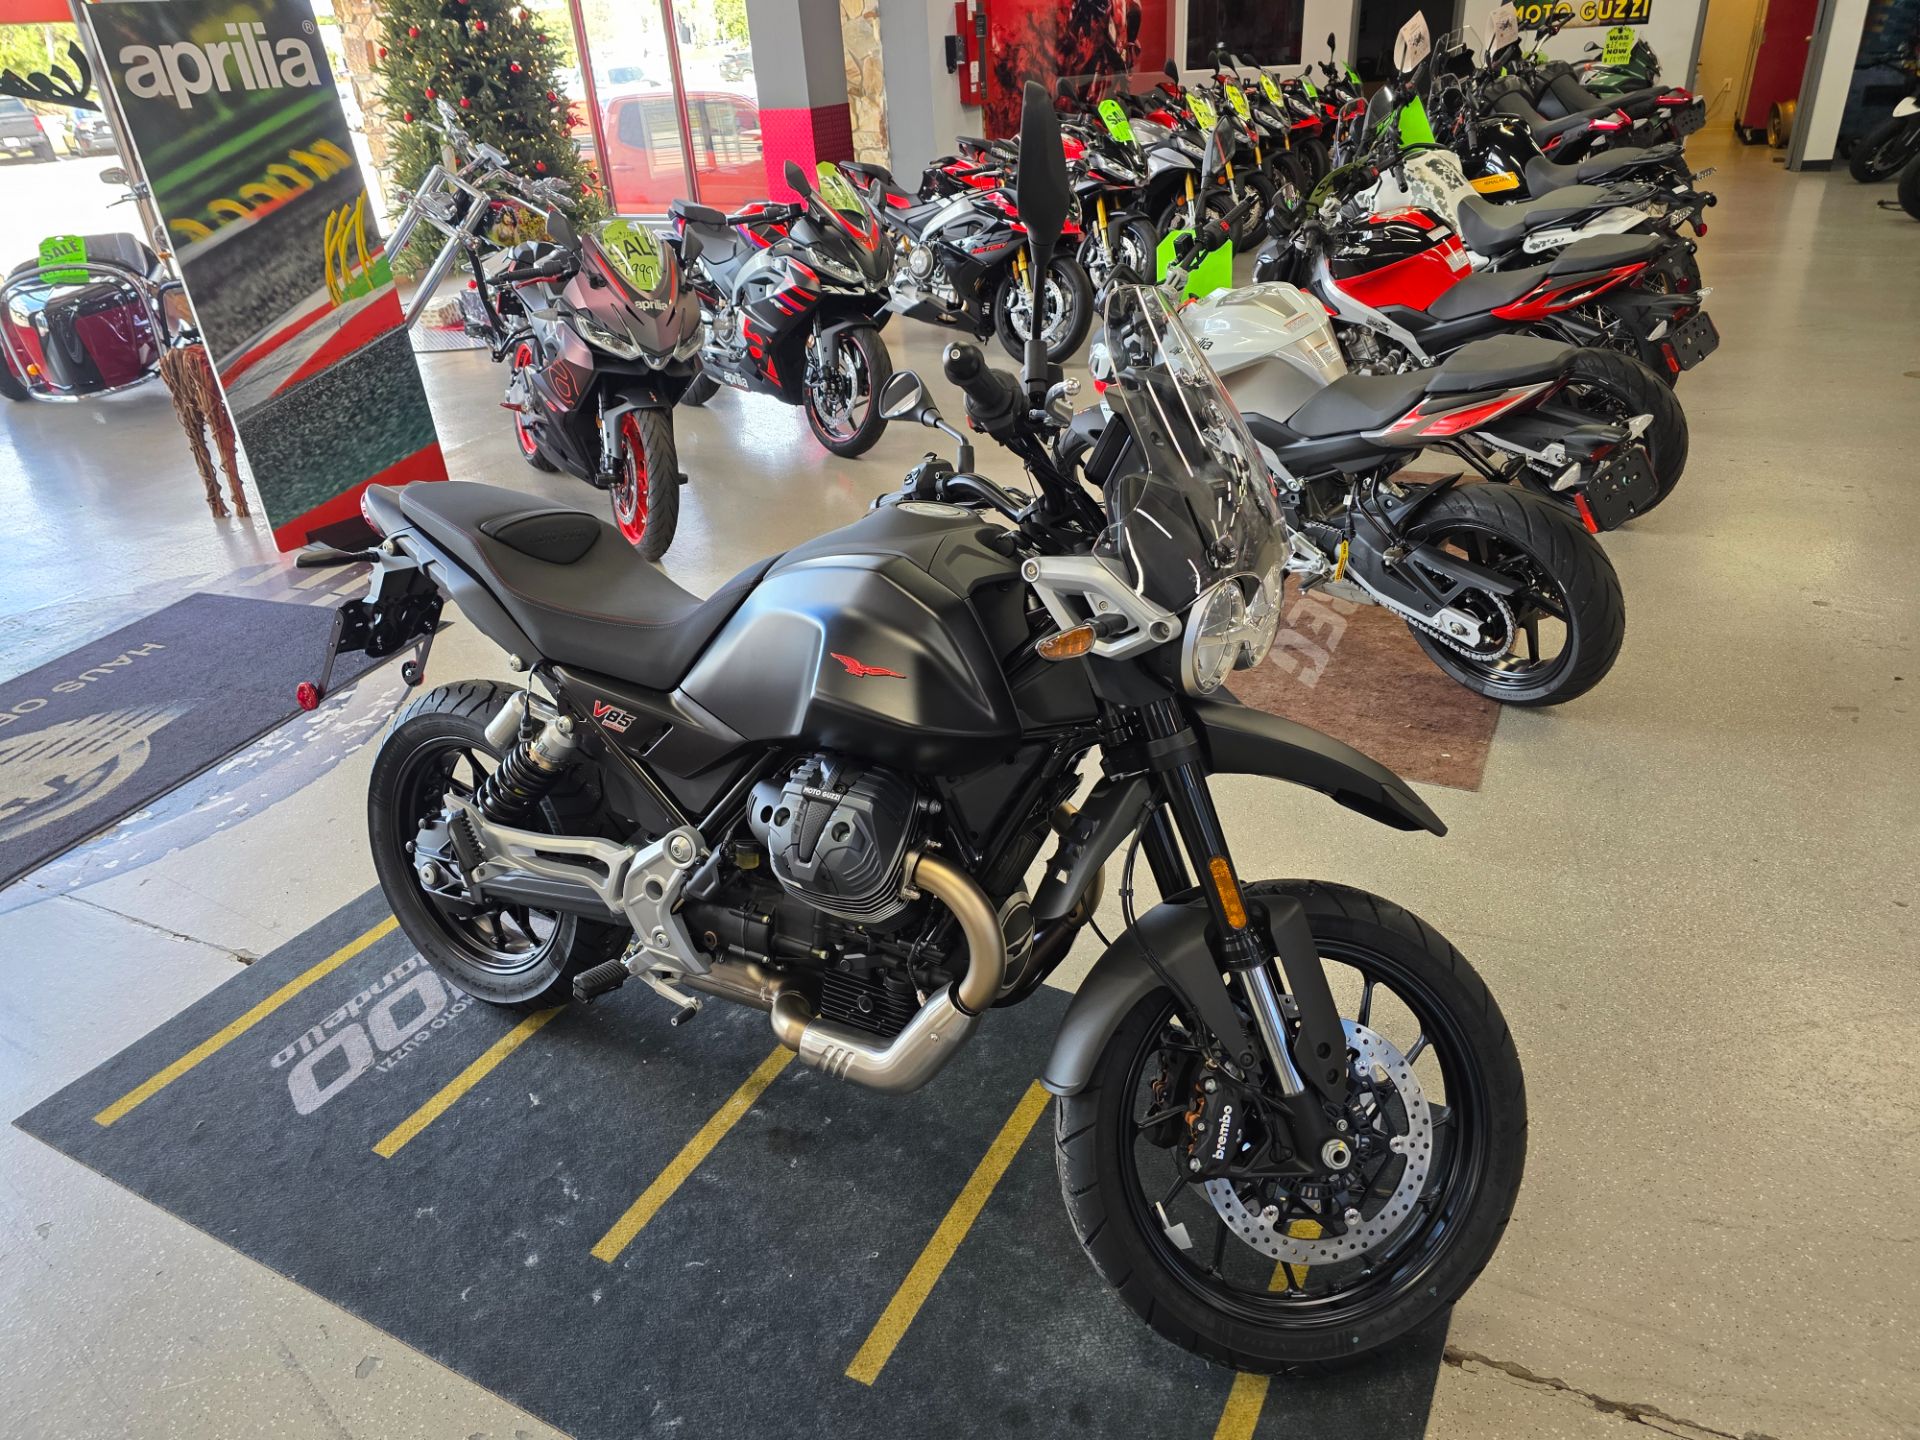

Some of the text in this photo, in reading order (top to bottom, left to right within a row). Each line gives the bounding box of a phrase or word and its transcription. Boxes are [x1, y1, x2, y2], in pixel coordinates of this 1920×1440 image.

[1580, 0, 1649, 20] GUZZI
[119, 22, 322, 109] aprilia
[41, 240, 81, 261] SALE
[634, 299, 668, 312] aprilia
[723, 371, 749, 388] aprilia
[52, 643, 166, 693] HAUS
[593, 699, 638, 728] V85
[803, 786, 841, 801] MOTO GUZZI
[376, 995, 474, 1073] MOTO GUZZI
[1212, 1105, 1233, 1160] brembo
